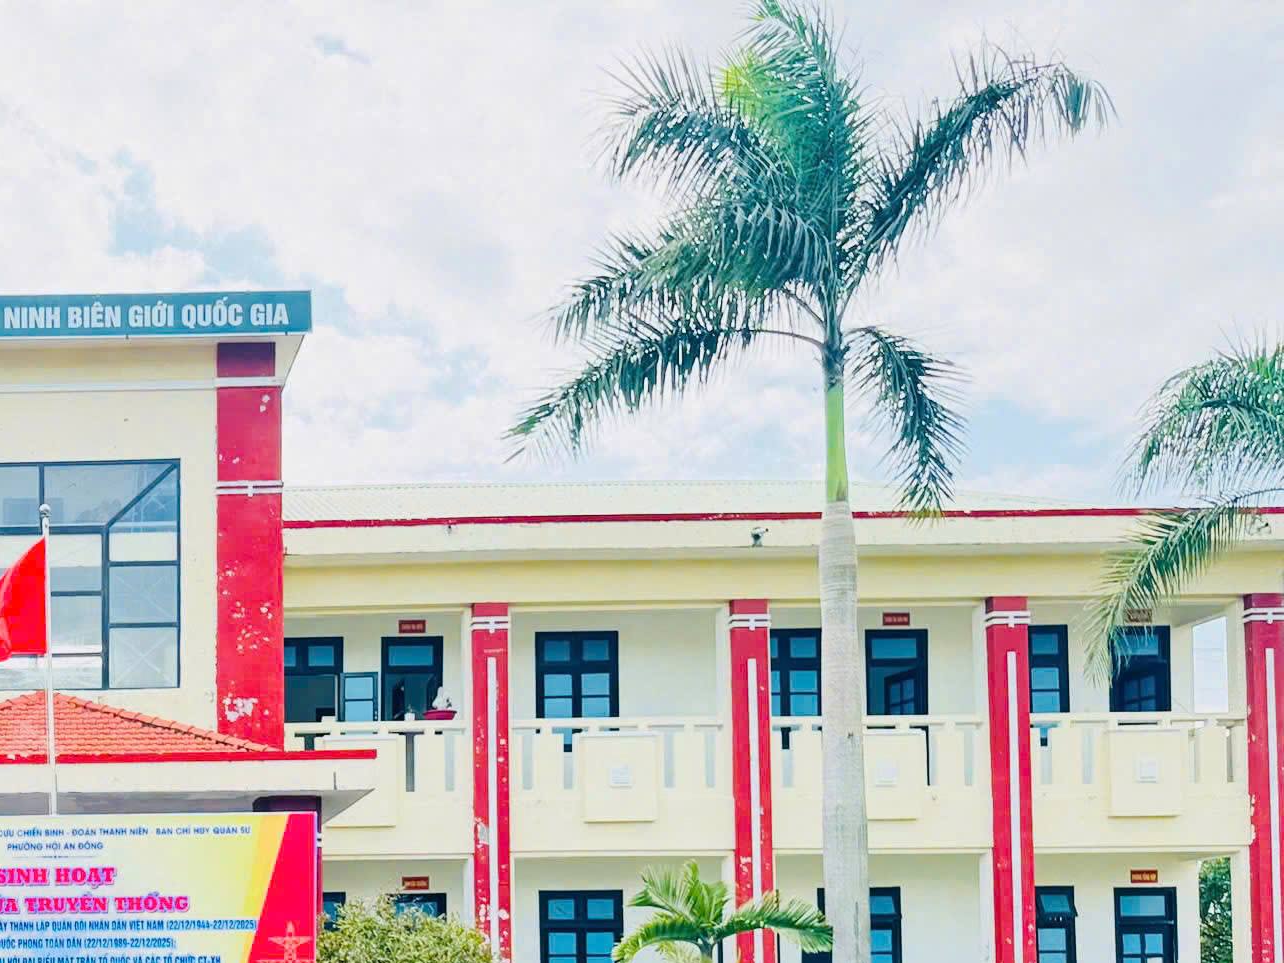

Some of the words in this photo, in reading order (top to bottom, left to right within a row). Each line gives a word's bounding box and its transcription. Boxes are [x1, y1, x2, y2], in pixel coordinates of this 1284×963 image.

[4, 307, 60, 329] NINH
[68, 301, 121, 329] BIÊN
[129, 300, 174, 328] GIỚI
[182, 296, 244, 328] QUỐC
[250, 303, 289, 326] GIA
[45, 829, 64, 837] BINH
[100, 828, 127, 836] THANH
[130, 827, 148, 835] NIÊN
[156, 827, 173, 835] BAN
[55, 867, 116, 889] HOẠT
[25, 892, 109, 914] TRUYỀN
[114, 891, 189, 913] THỐNG
[129, 918, 144, 932] VIỆT
[147, 920, 164, 931] NAM
